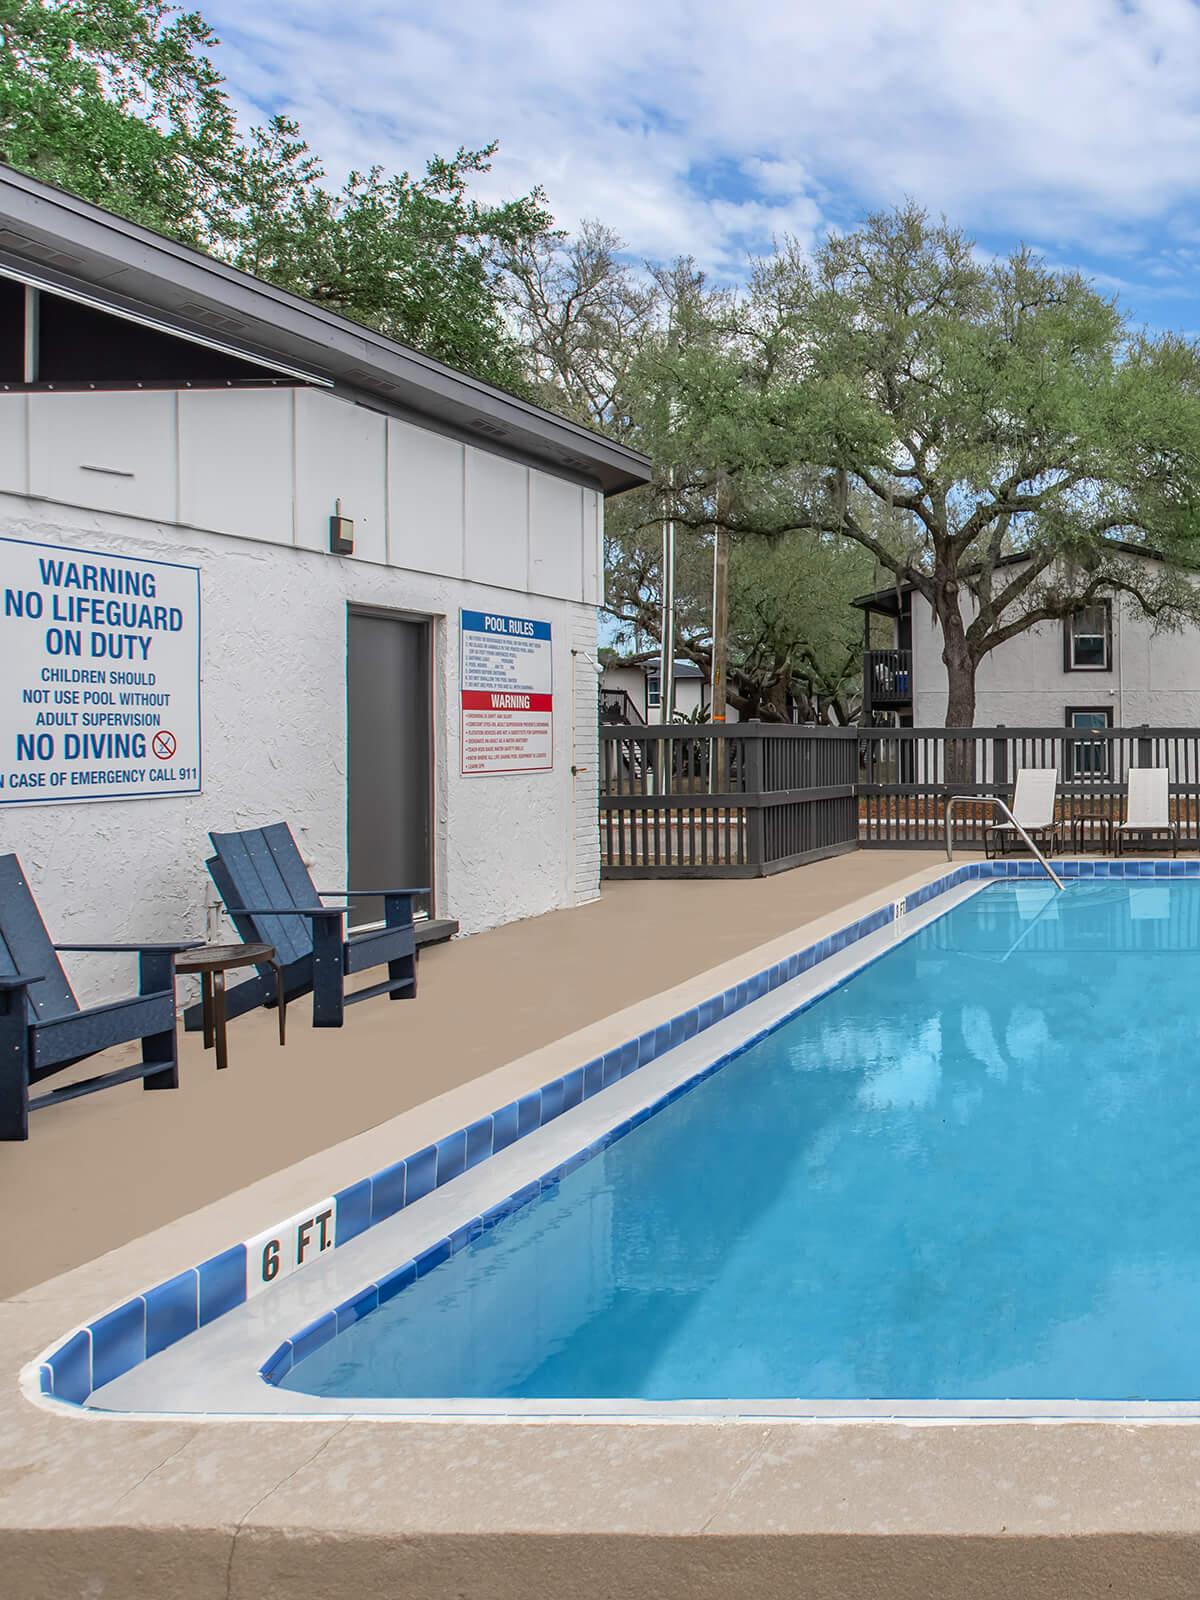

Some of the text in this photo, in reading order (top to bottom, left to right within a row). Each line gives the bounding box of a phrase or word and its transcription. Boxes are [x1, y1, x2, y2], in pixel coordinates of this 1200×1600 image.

[38, 558, 156, 598] WARNING
[4, 588, 183, 632] NO LIFEGUARD
[485, 616, 534, 636] POOL RULES
[46, 628, 153, 660] ON DUTY
[41, 667, 156, 686] CHILDREN SHOULD
[23, 689, 171, 706] NOT USE POOL WITHOUT
[491, 693, 531, 709] WARNING
[36, 712, 161, 727] ADULT SUPERVISION
[16, 733, 147, 761] NO DIVING
[9, 773, 46, 788] CASE
[50, 772, 67, 786] OF
[71, 769, 146, 785] EMERGENCY
[149, 768, 176, 782] CALL
[179, 767, 197, 780] 911
[262, 1209, 332, 1282] 6 FT.
